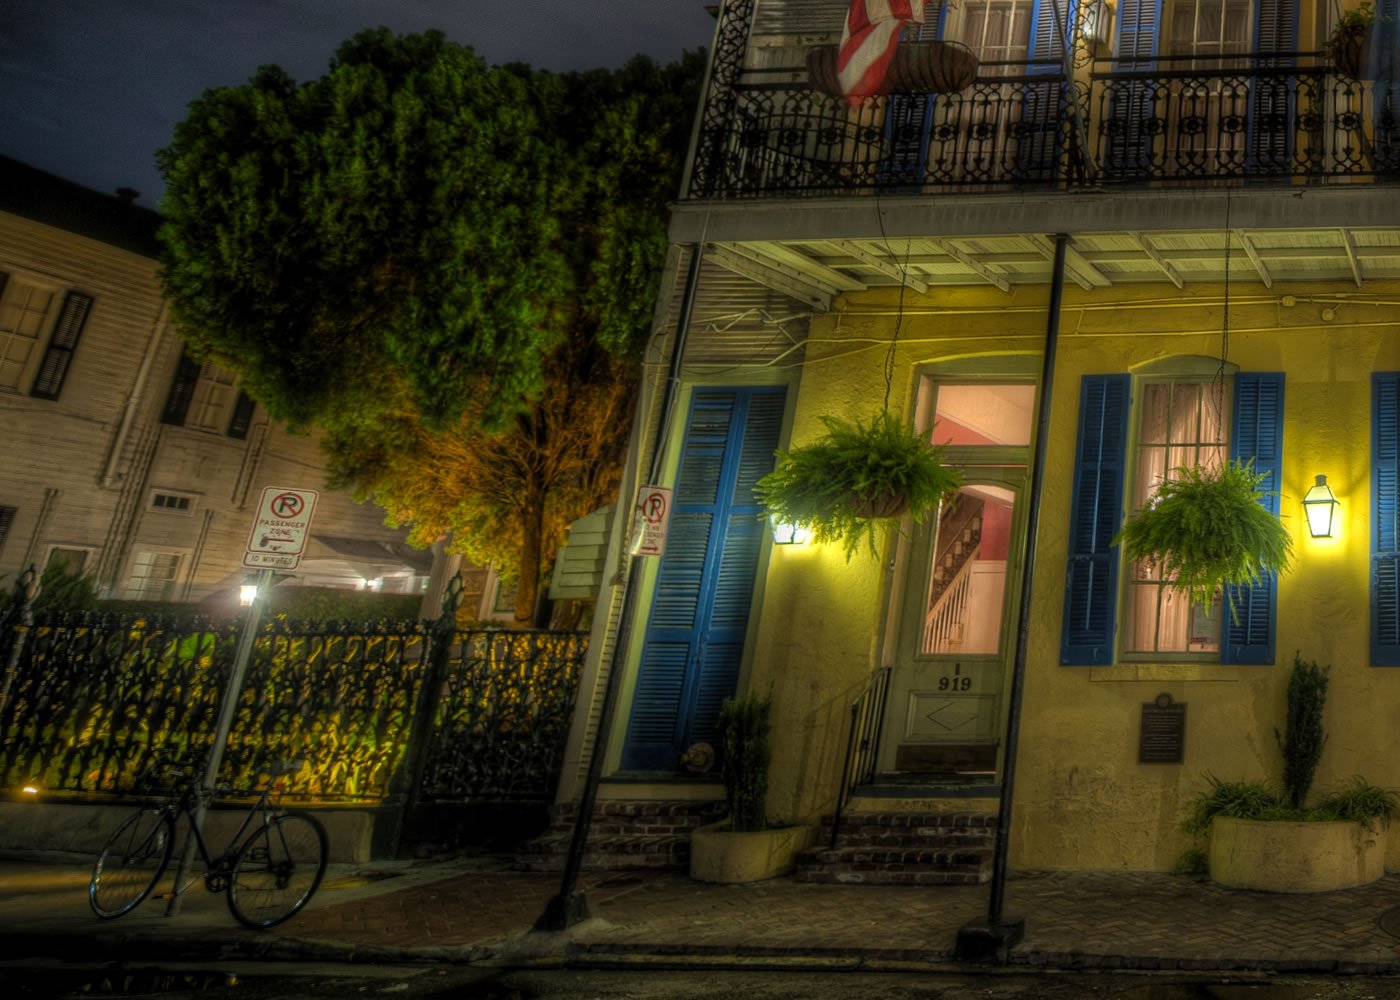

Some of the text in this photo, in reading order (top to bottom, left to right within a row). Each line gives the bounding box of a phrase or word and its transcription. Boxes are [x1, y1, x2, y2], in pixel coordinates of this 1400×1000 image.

[259, 519, 305, 529] PASSENGER
[270, 528, 292, 536] ZONE
[262, 556, 293, 565] MINUTES
[938, 676, 972, 691] 919
